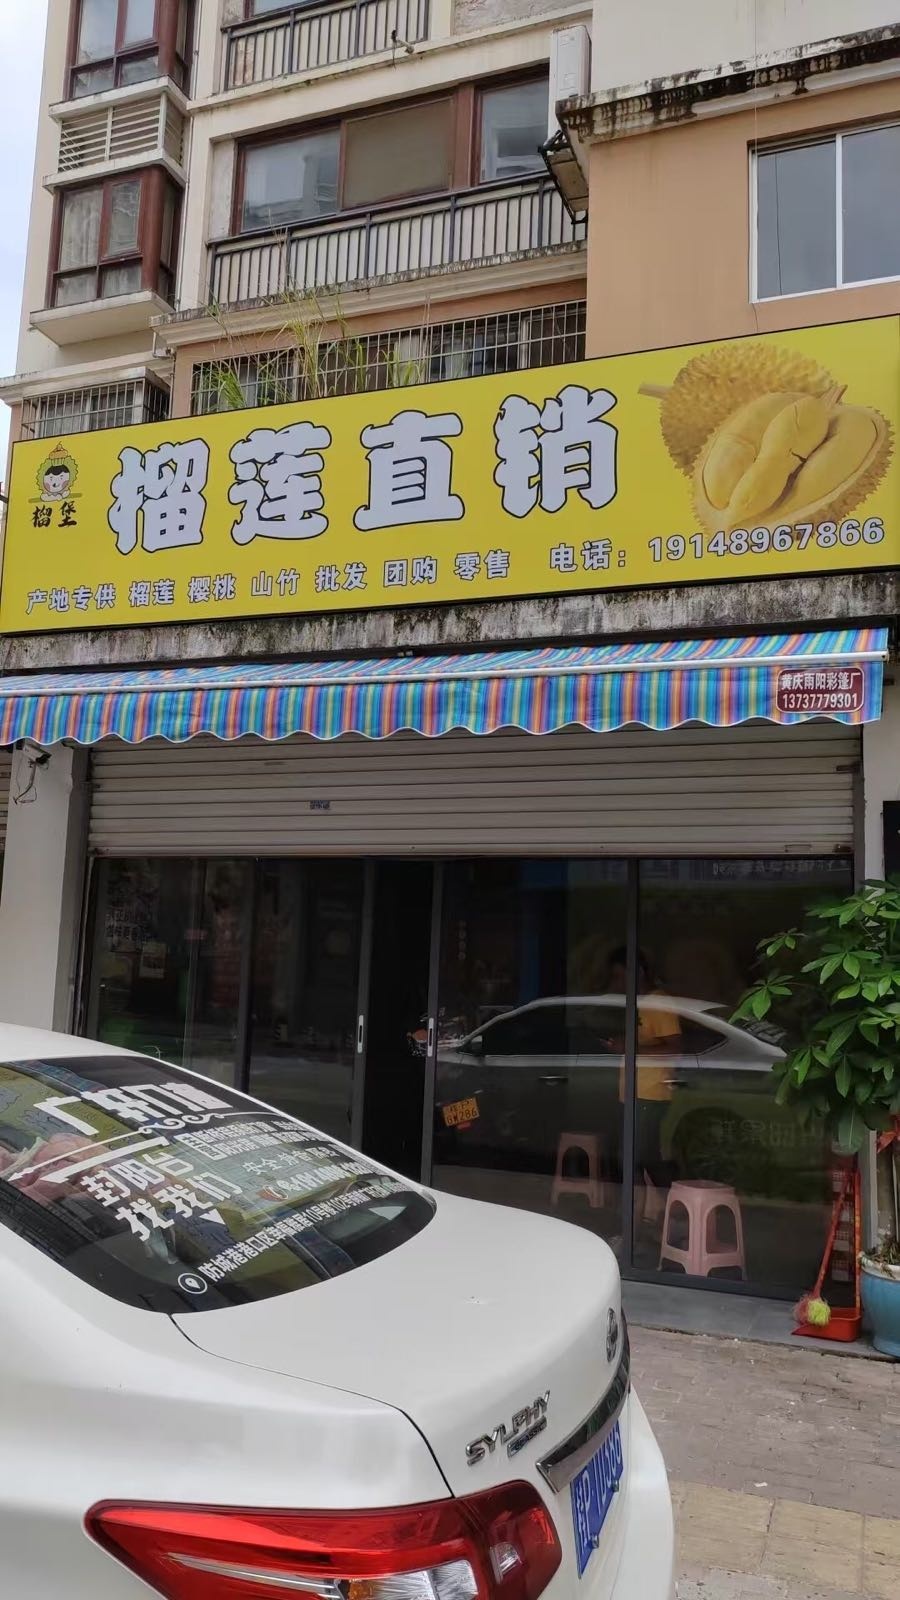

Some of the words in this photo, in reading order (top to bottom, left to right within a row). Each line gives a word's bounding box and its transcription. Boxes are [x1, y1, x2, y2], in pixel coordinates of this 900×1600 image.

[107, 385, 619, 555] 榴莲直销
[32, 501, 77, 528] 榴堡
[649, 517, 886, 562] 19148967866
[26, 584, 116, 615] 产地专供
[129, 579, 175, 607] 榴莲
[188, 573, 236, 603] 樱桃
[251, 569, 300, 597] 山竹
[315, 561, 367, 593] 批发
[383, 556, 437, 587] 团购
[454, 549, 510, 581] 零售
[782, 693, 858, 709] 13737779301
[80, 1151, 194, 1207] 封阳台
[114, 1171, 243, 1242] 找我们
[465, 1389, 551, 1467] SYLPHY
